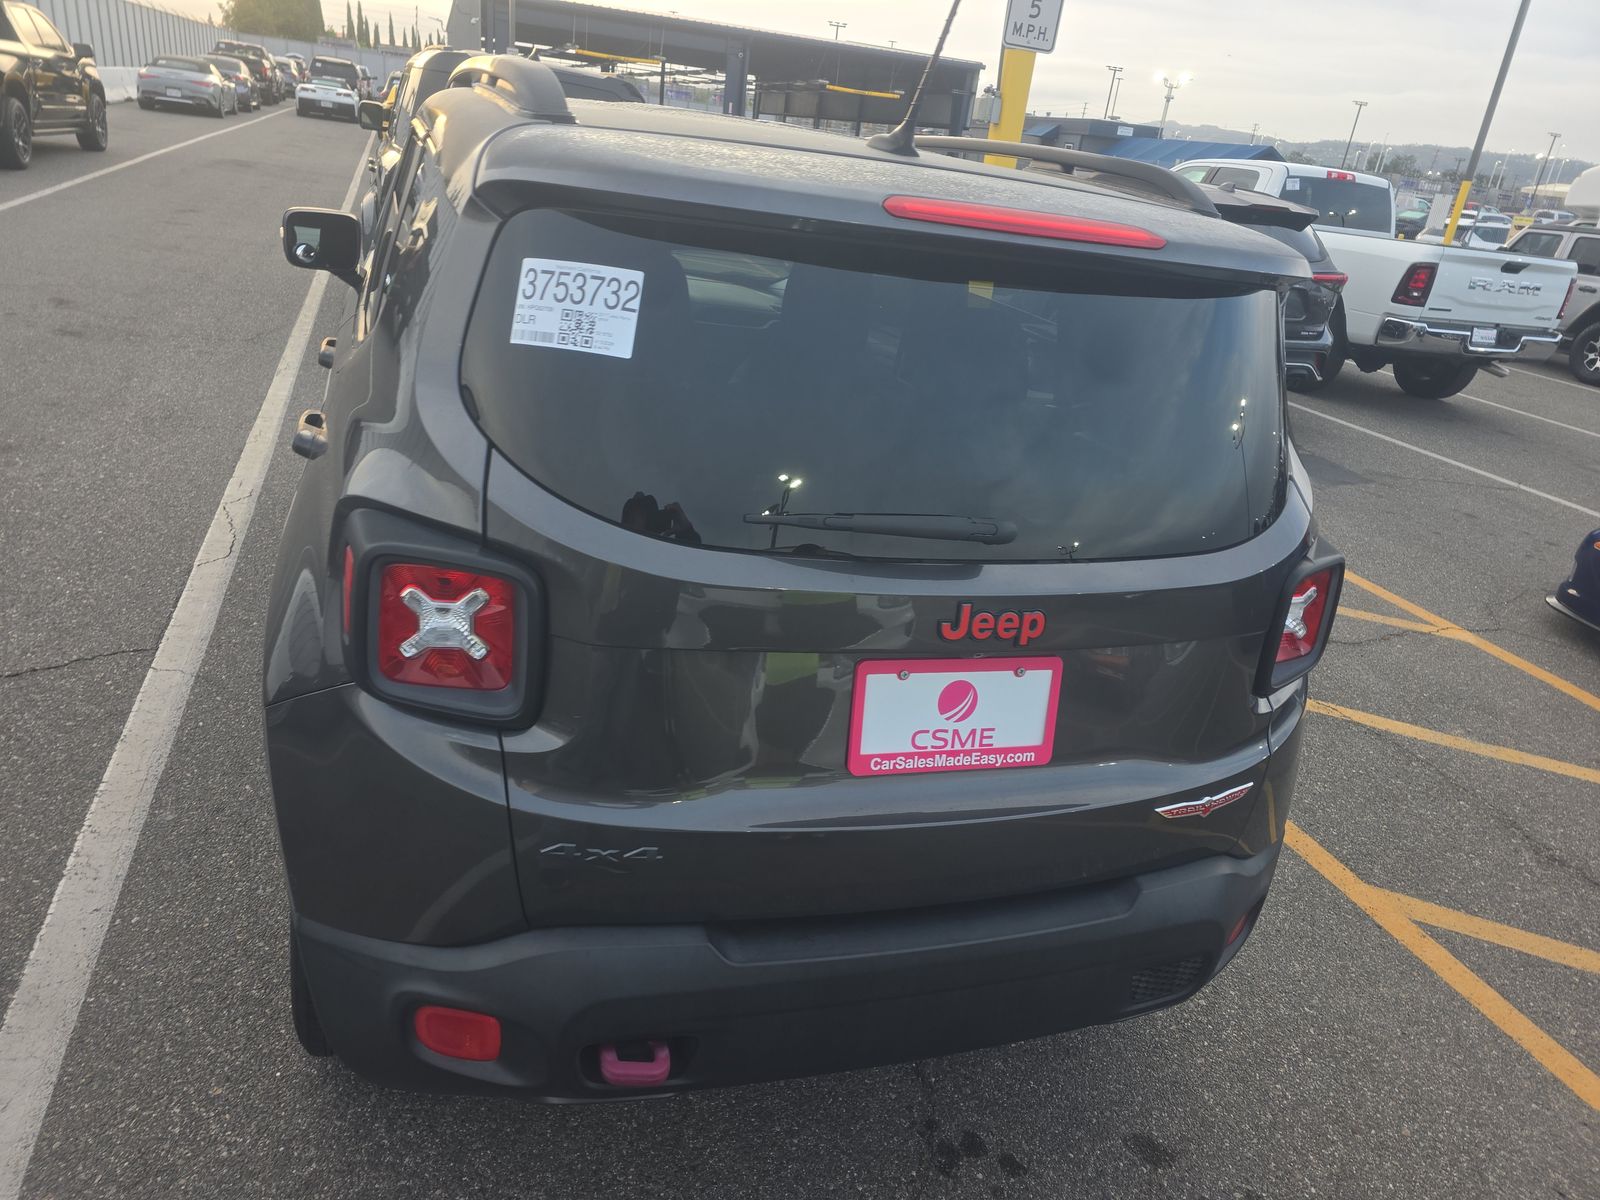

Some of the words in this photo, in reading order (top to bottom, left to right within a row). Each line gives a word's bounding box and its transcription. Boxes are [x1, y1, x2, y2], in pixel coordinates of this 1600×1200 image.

[1028, 0, 1042, 18] 5
[1012, 21, 1049, 42] M.P.H.
[522, 267, 640, 313] 3753732
[1467, 276, 1543, 297] RAM
[938, 602, 1046, 646] Jeep
[910, 727, 996, 750] CSME
[870, 751, 1035, 771] CarSalesMadeEasy.com
